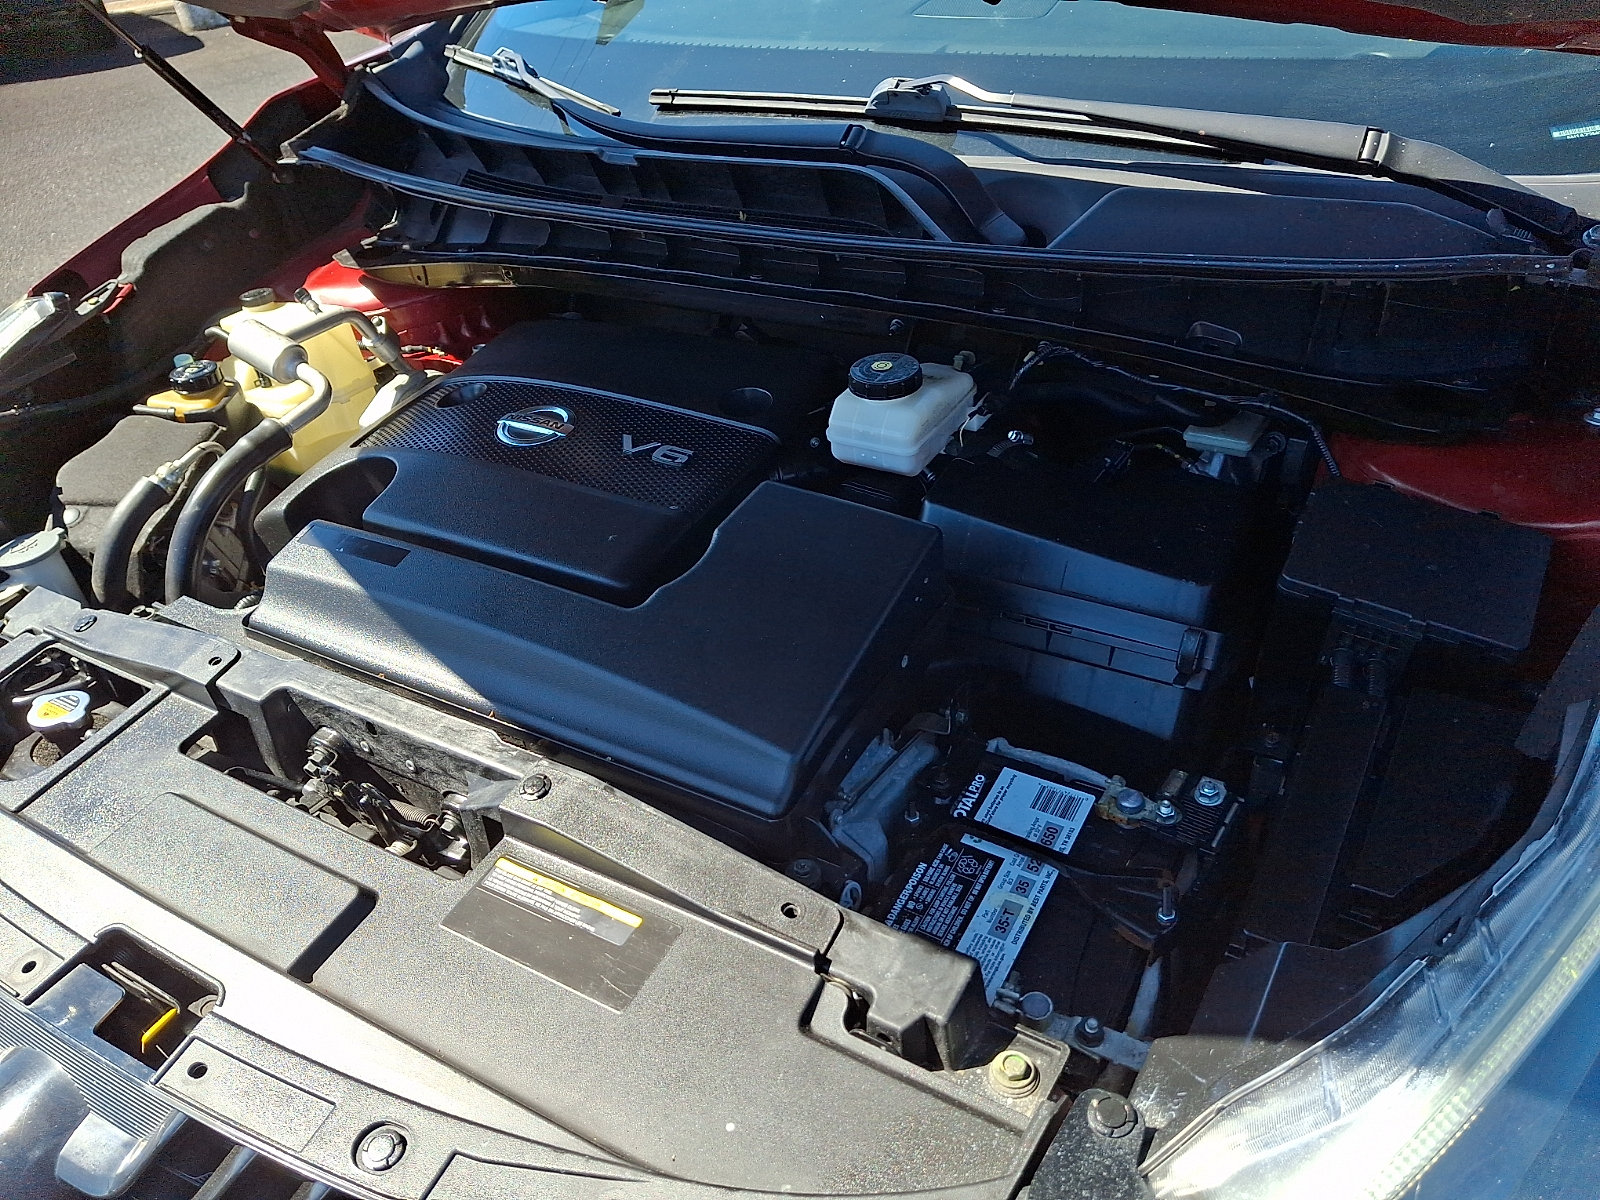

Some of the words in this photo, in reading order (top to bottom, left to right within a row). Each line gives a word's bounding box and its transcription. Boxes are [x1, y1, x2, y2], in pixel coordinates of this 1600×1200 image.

[506, 414, 565, 430] NISSAN
[622, 434, 694, 466] V6
[953, 774, 985, 818] OTALPRO
[1040, 827, 1058, 846] 650
[1027, 858, 1043, 872] 52
[888, 863, 926, 919] DANGER/POISON
[1016, 880, 1029, 893] 35
[907, 901, 915, 909] NO
[1011, 915, 1031, 944] DISTRIBUTED
[1031, 895, 1040, 907] BEST
[1037, 880, 1049, 895] PARTS,
[995, 908, 1014, 933] 35-T
